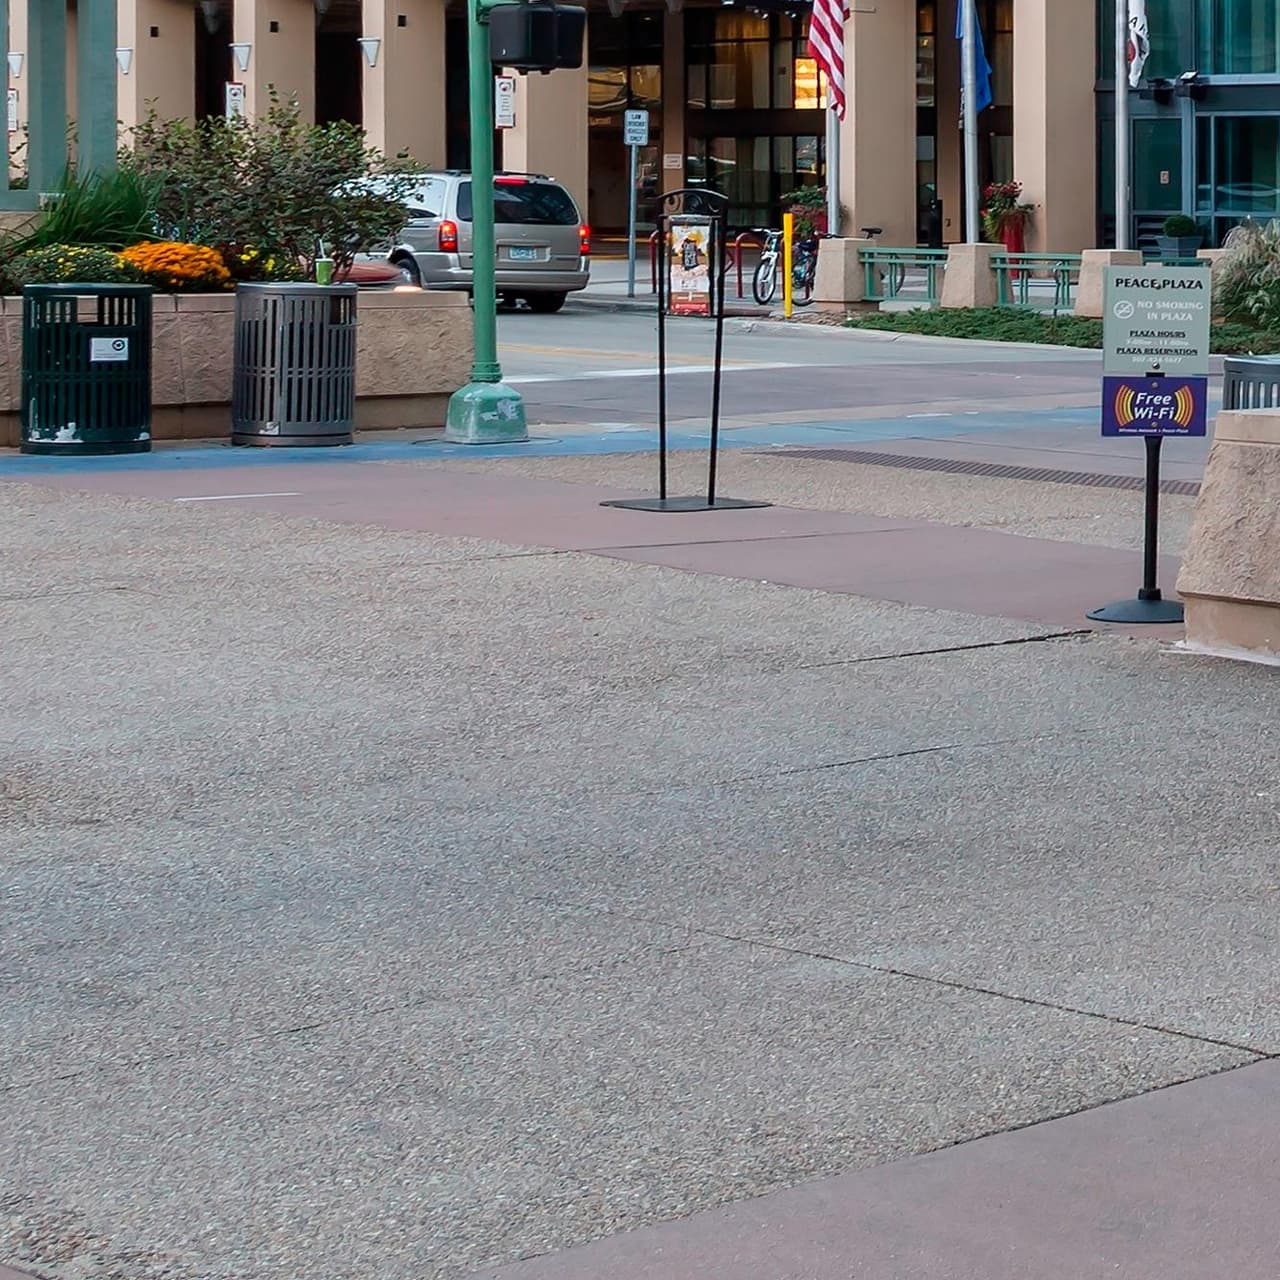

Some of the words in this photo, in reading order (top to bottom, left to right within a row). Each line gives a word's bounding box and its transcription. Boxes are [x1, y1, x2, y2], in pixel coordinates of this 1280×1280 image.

[1115, 277, 1158, 289] PEACE
[1162, 279, 1204, 290] PLAZA
[1137, 300, 1153, 309] NO
[1155, 300, 1204, 310] SMOKING
[1146, 312, 1158, 321] IN
[1161, 312, 1193, 321] PLAZA
[1129, 330, 1156, 338] PLAZA
[1116, 347, 1143, 355] PLAZA
[1136, 392, 1172, 406] Free
[1134, 406, 1175, 420] Wi-Fi
